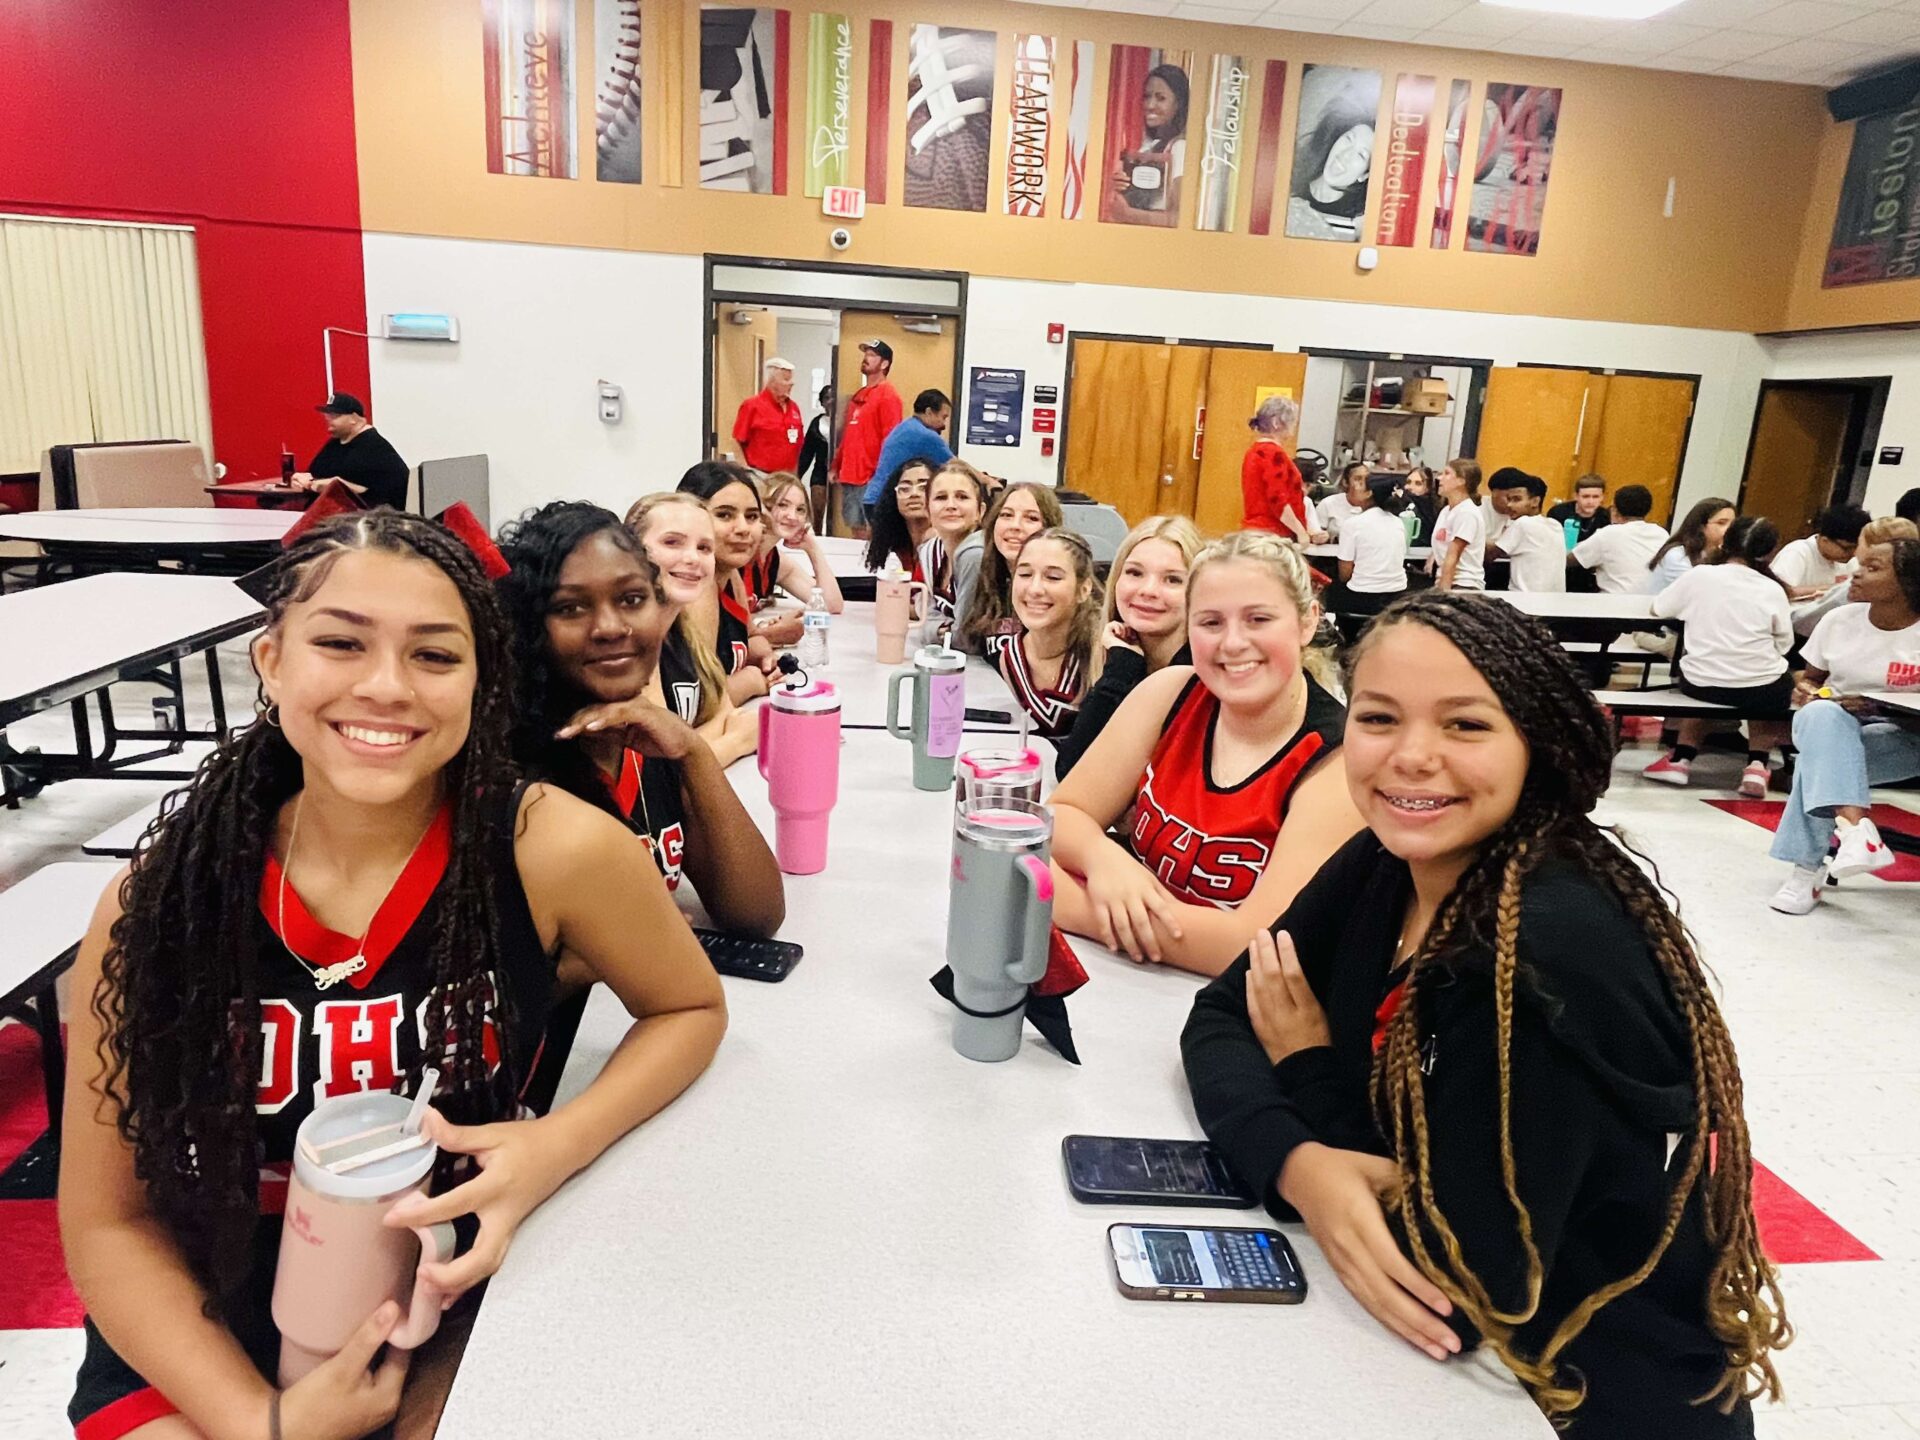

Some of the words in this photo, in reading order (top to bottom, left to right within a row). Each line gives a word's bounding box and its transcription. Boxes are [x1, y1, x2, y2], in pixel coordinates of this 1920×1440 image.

[501, 31, 550, 170] Achieve
[813, 19, 850, 172] Perseverance
[1008, 47, 1051, 206] TEAMWORK
[1201, 67, 1250, 173] Fellowship
[830, 188, 860, 214] EXIT
[1379, 112, 1424, 236] Dedication
